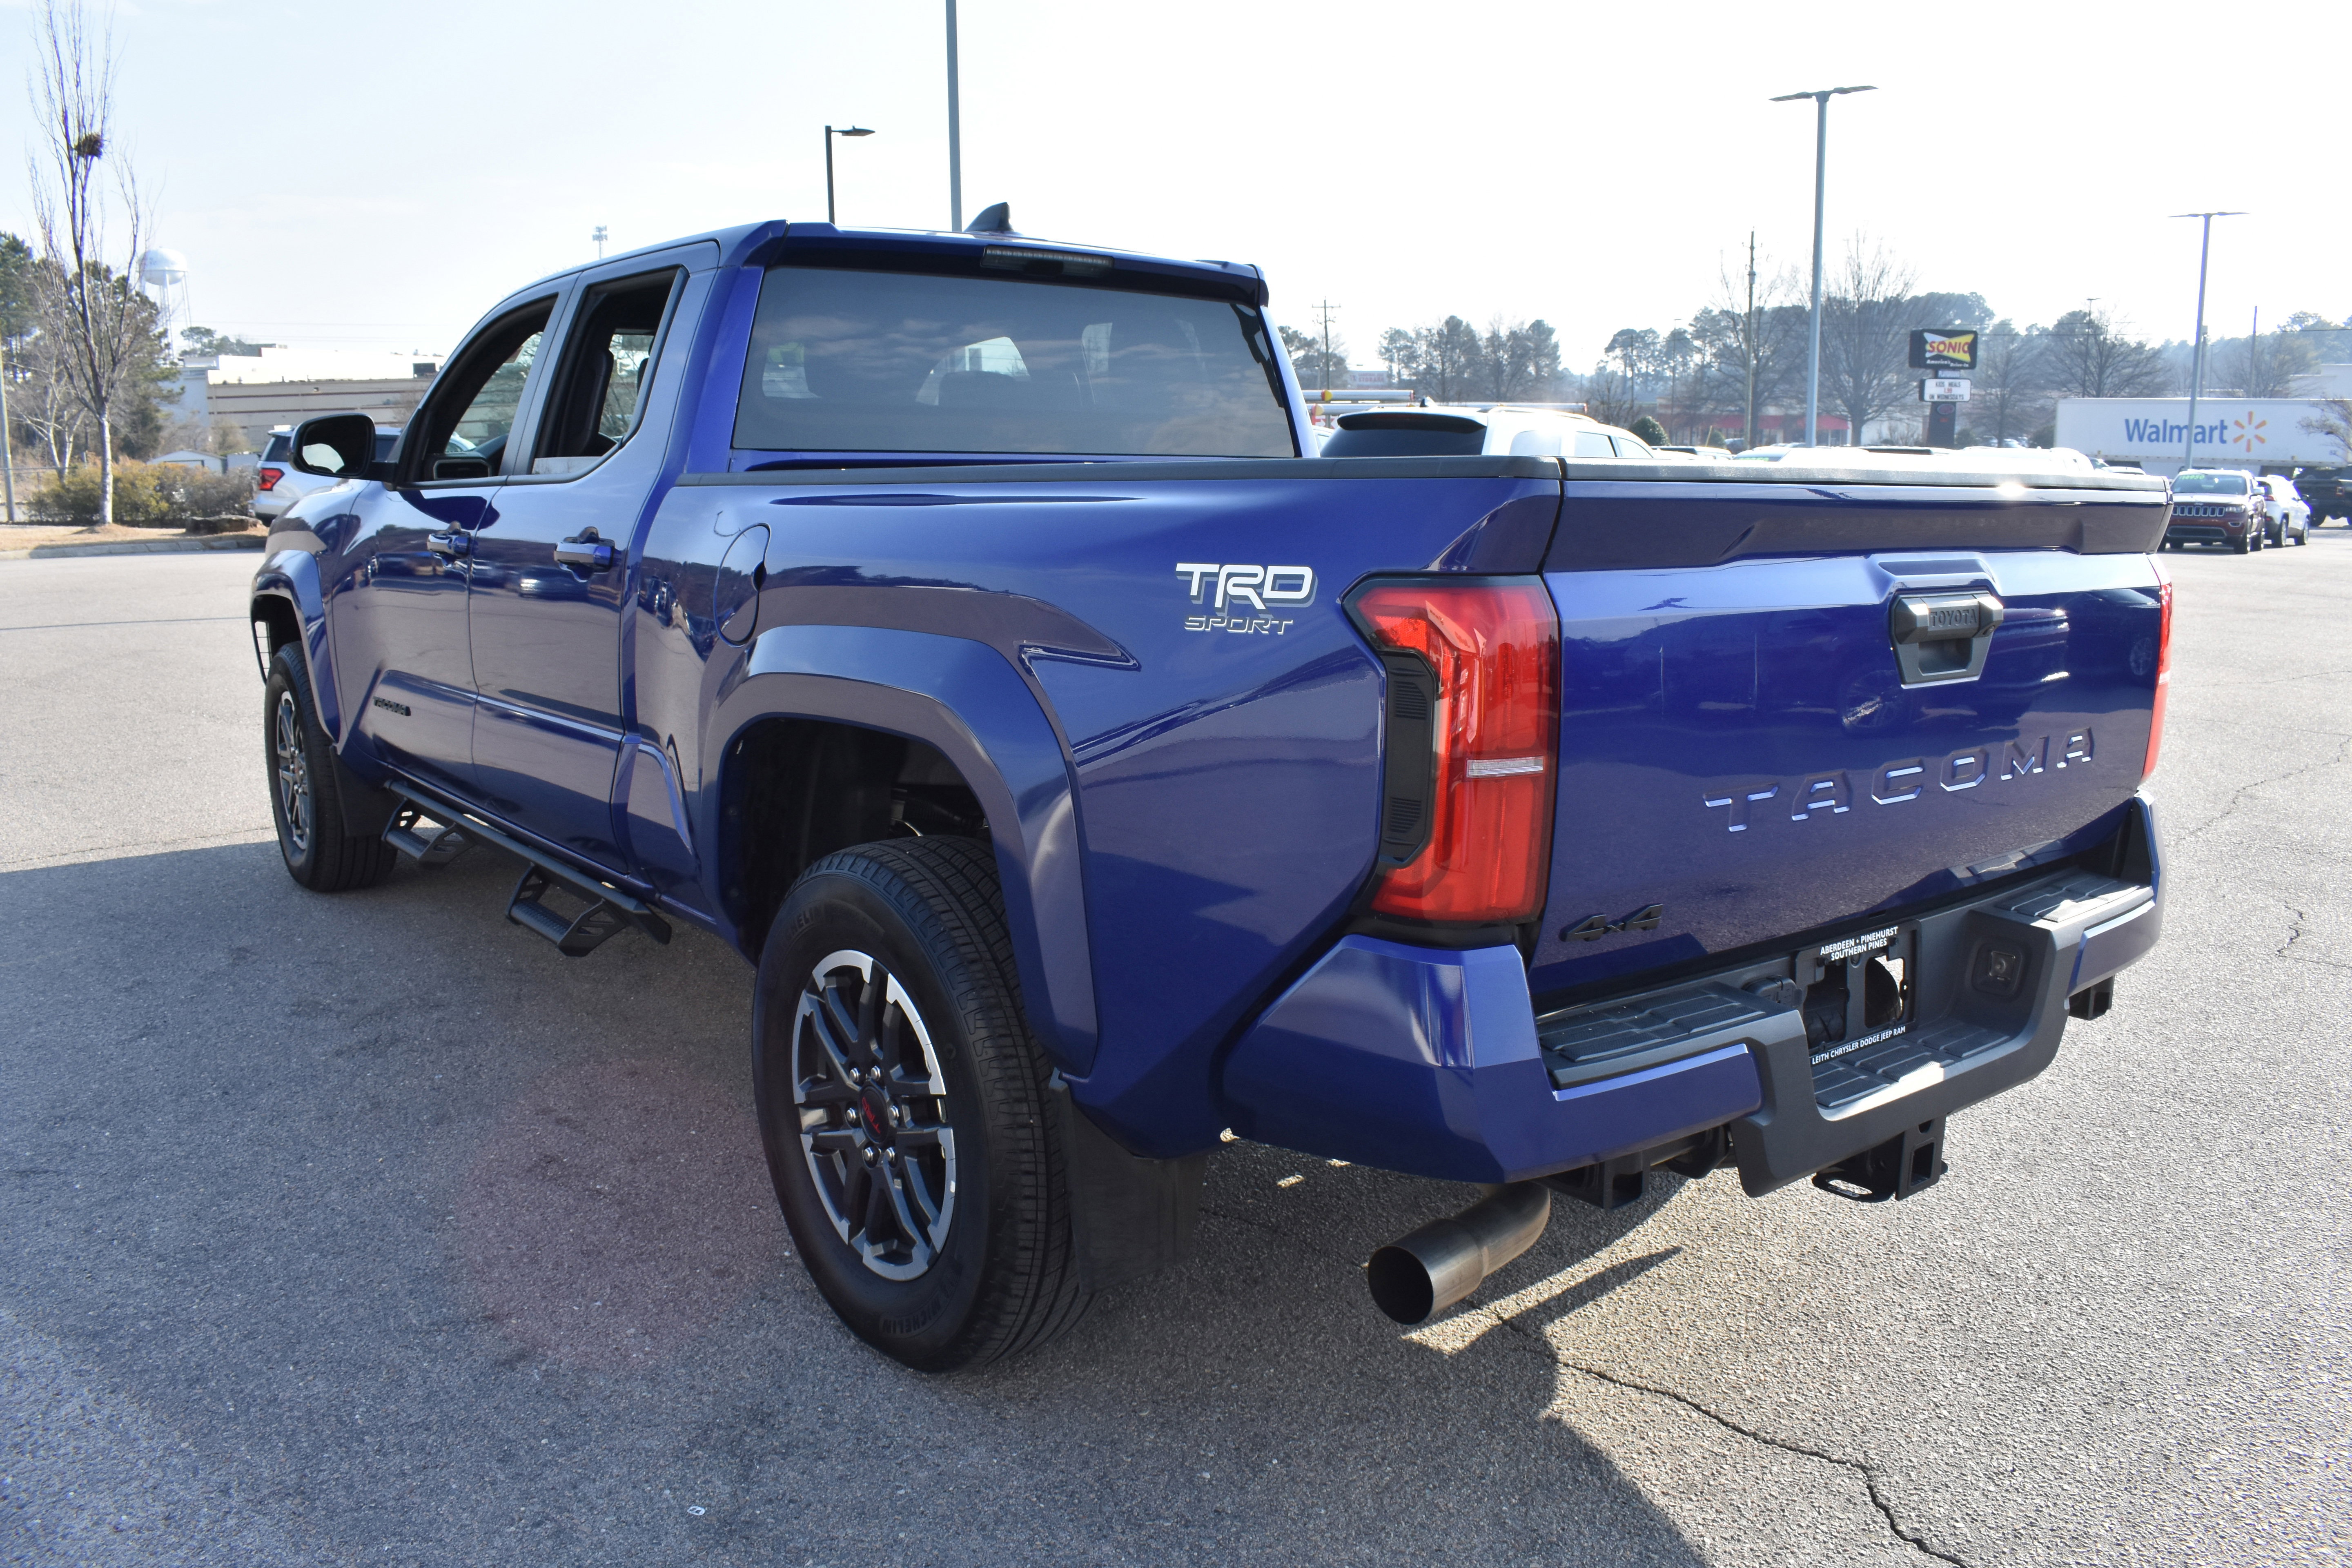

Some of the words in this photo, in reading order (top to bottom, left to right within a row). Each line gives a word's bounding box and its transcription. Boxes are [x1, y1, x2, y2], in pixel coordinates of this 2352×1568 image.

[1929, 341, 1970, 353] SONIC
[2125, 419, 2227, 444] Walmart
[1176, 563, 1316, 616] TRD
[1184, 615, 1294, 635] SPORT
[1930, 609, 1977, 627] TOYOTA
[1703, 726, 2094, 832] TACOMA
[1820, 938, 1854, 955] ABERDEEN
[1860, 926, 1898, 944] PINEHURST
[1831, 943, 1866, 961] SOUTHERN
[1868, 938, 1887, 950] PINES
[1812, 1052, 1829, 1065] LEITH
[1830, 1042, 1859, 1058] CHRYSLER
[1860, 1034, 1880, 1047] DODGE
[1880, 1030, 1892, 1042] JEEP
[1893, 1025, 1906, 1036] RAM
[882, 1294, 942, 1334] MICHELIN
